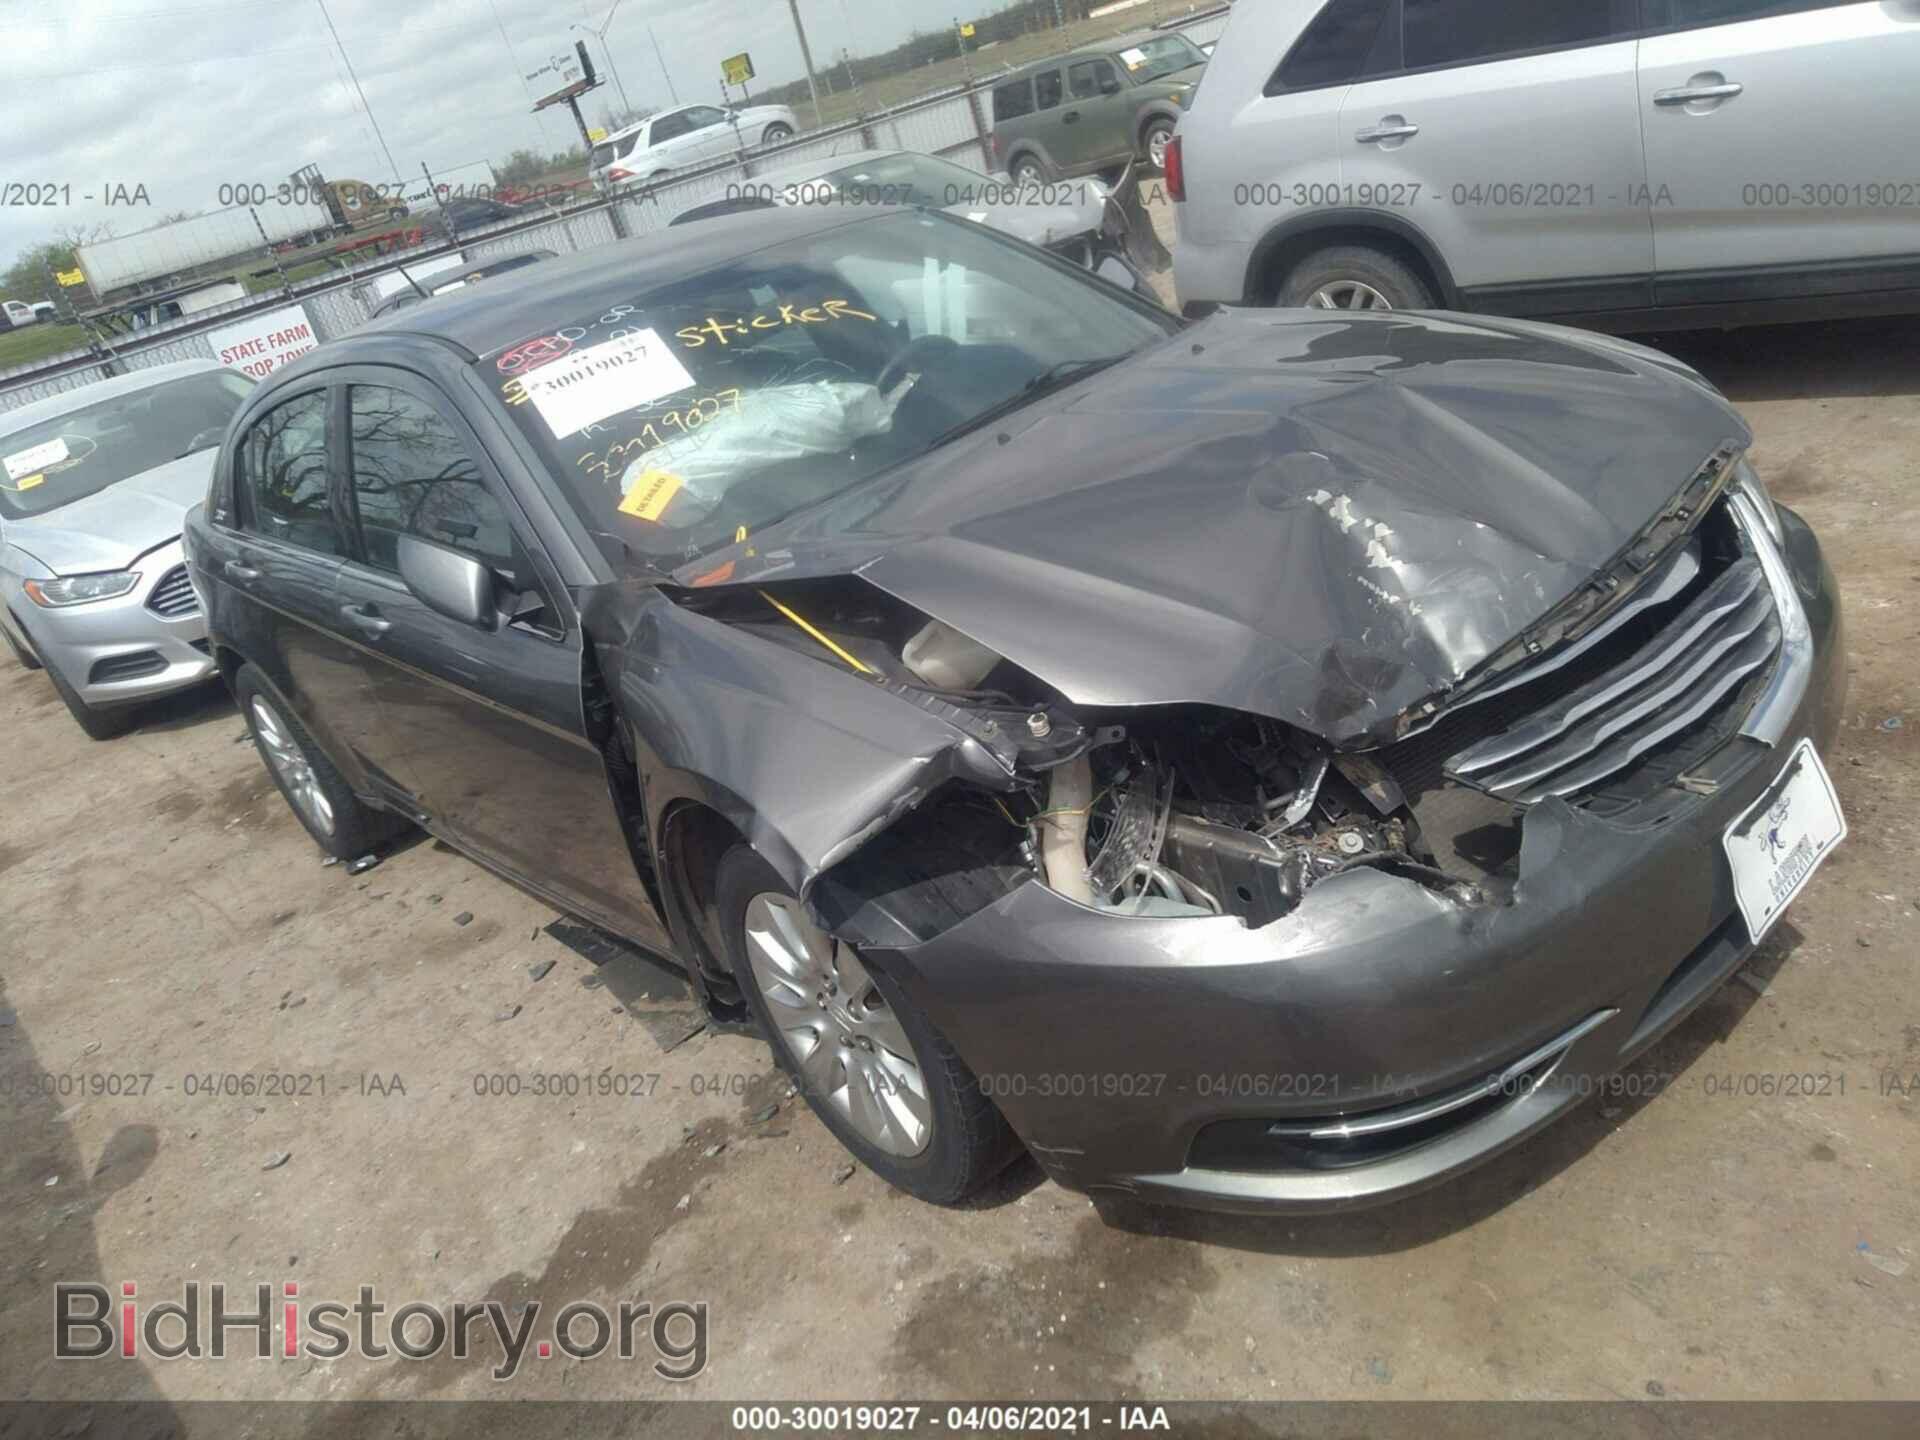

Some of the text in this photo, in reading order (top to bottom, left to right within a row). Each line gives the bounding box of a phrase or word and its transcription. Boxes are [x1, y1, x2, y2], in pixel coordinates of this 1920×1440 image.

[220, 323, 310, 365] STATE FARM
[242, 358, 274, 378] ROP
[545, 344, 648, 393] 30019027
